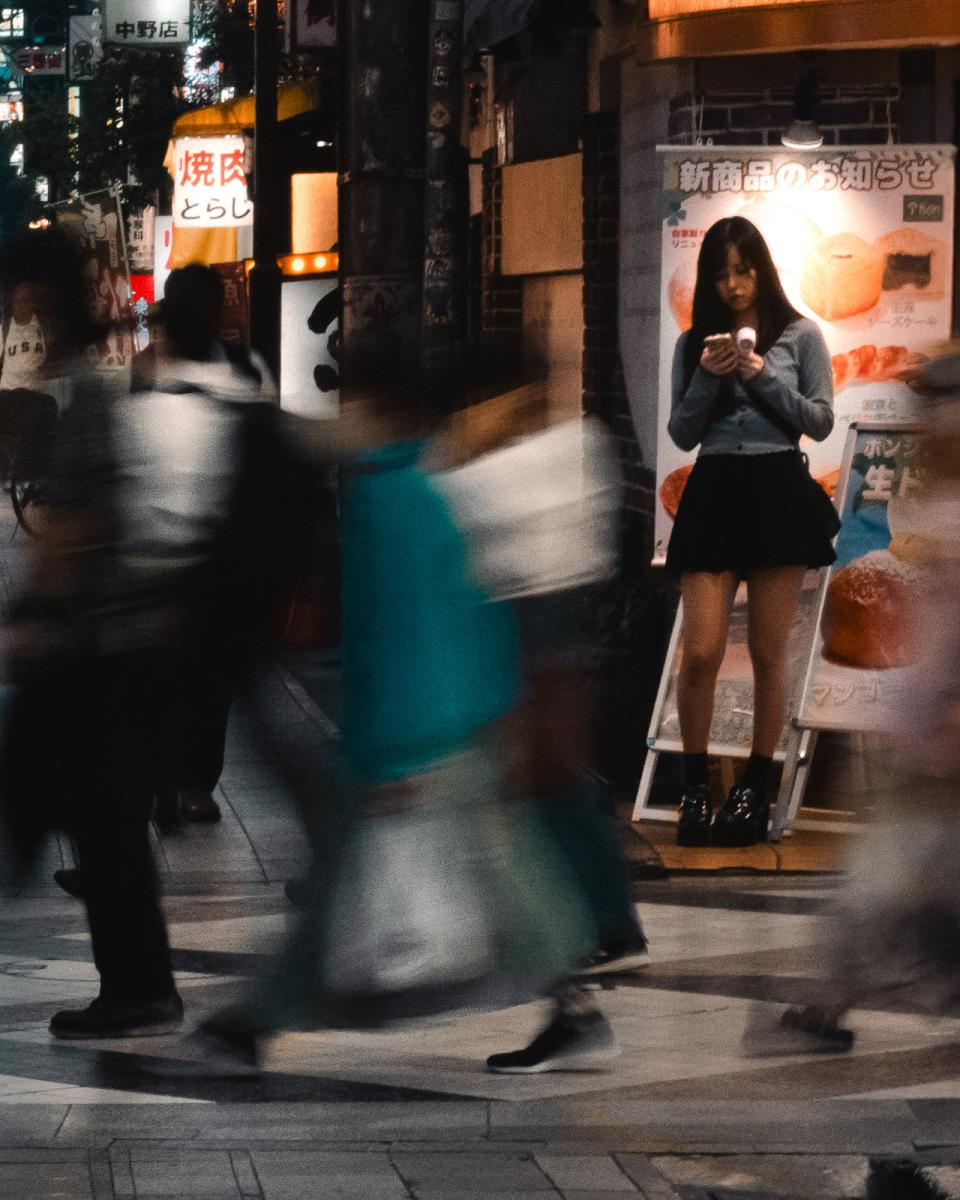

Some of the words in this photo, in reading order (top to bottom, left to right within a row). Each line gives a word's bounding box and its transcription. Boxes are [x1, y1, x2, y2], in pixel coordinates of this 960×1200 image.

[115, 20, 179, 39] 中野店
[180, 149, 247, 187] 焼肉
[678, 157, 939, 193] 新商品のお知らせ
[7, 341, 45, 358] USA
